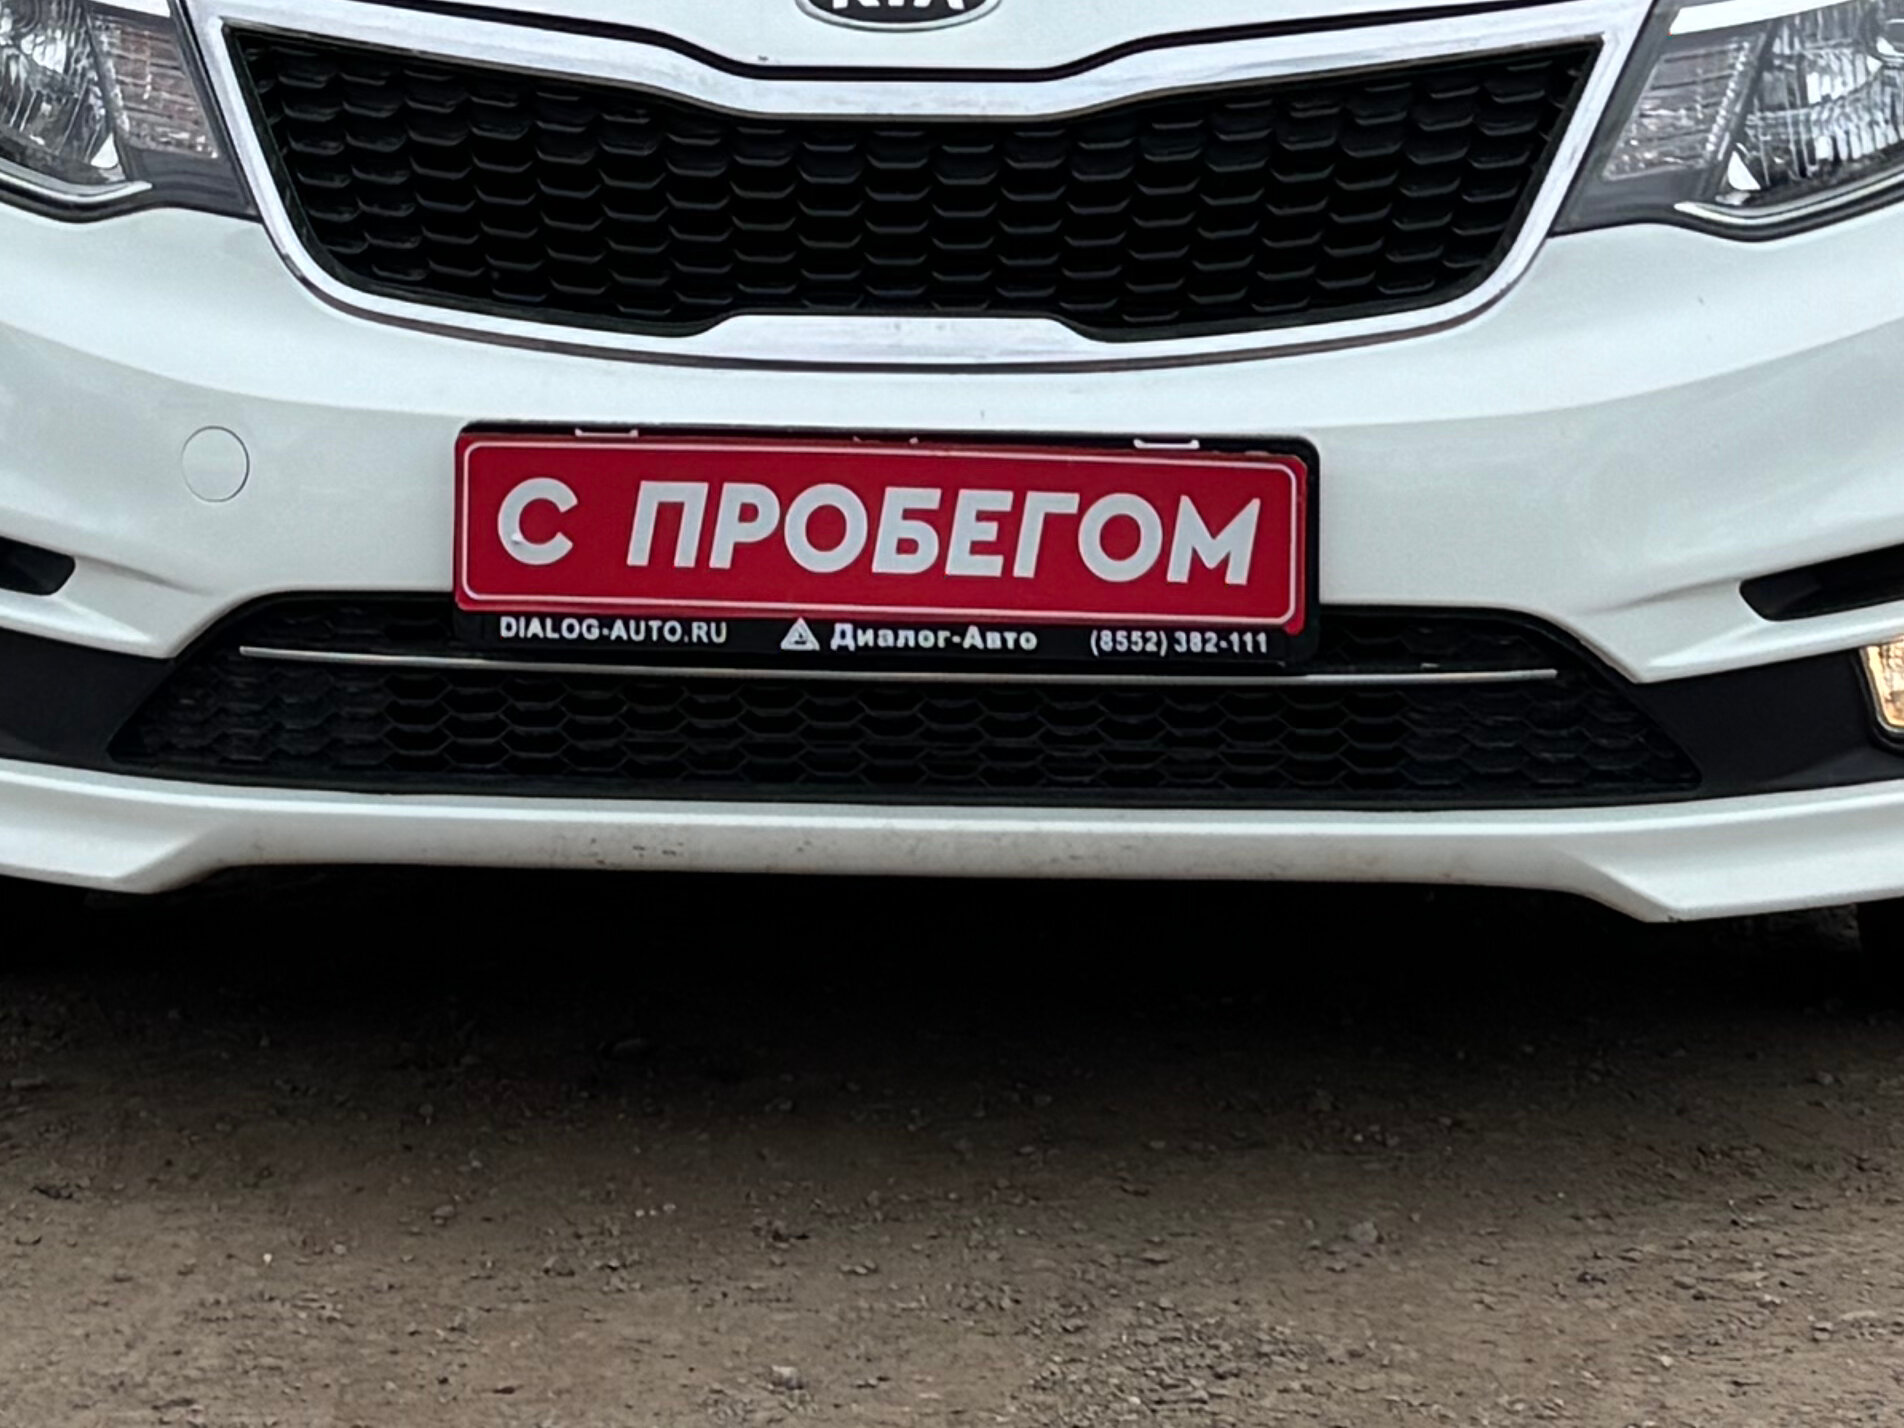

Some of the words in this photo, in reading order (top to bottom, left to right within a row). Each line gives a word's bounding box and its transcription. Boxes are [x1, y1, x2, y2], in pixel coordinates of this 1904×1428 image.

[496, 477, 579, 566] С
[626, 480, 1261, 587] ПРОБЕГОМ
[499, 616, 728, 643] DIALOG-AUTO.RU
[830, 622, 1038, 652] Диалог-Авто
[1090, 629, 1168, 657] (8552)
[1174, 630, 1268, 654] 382-111
